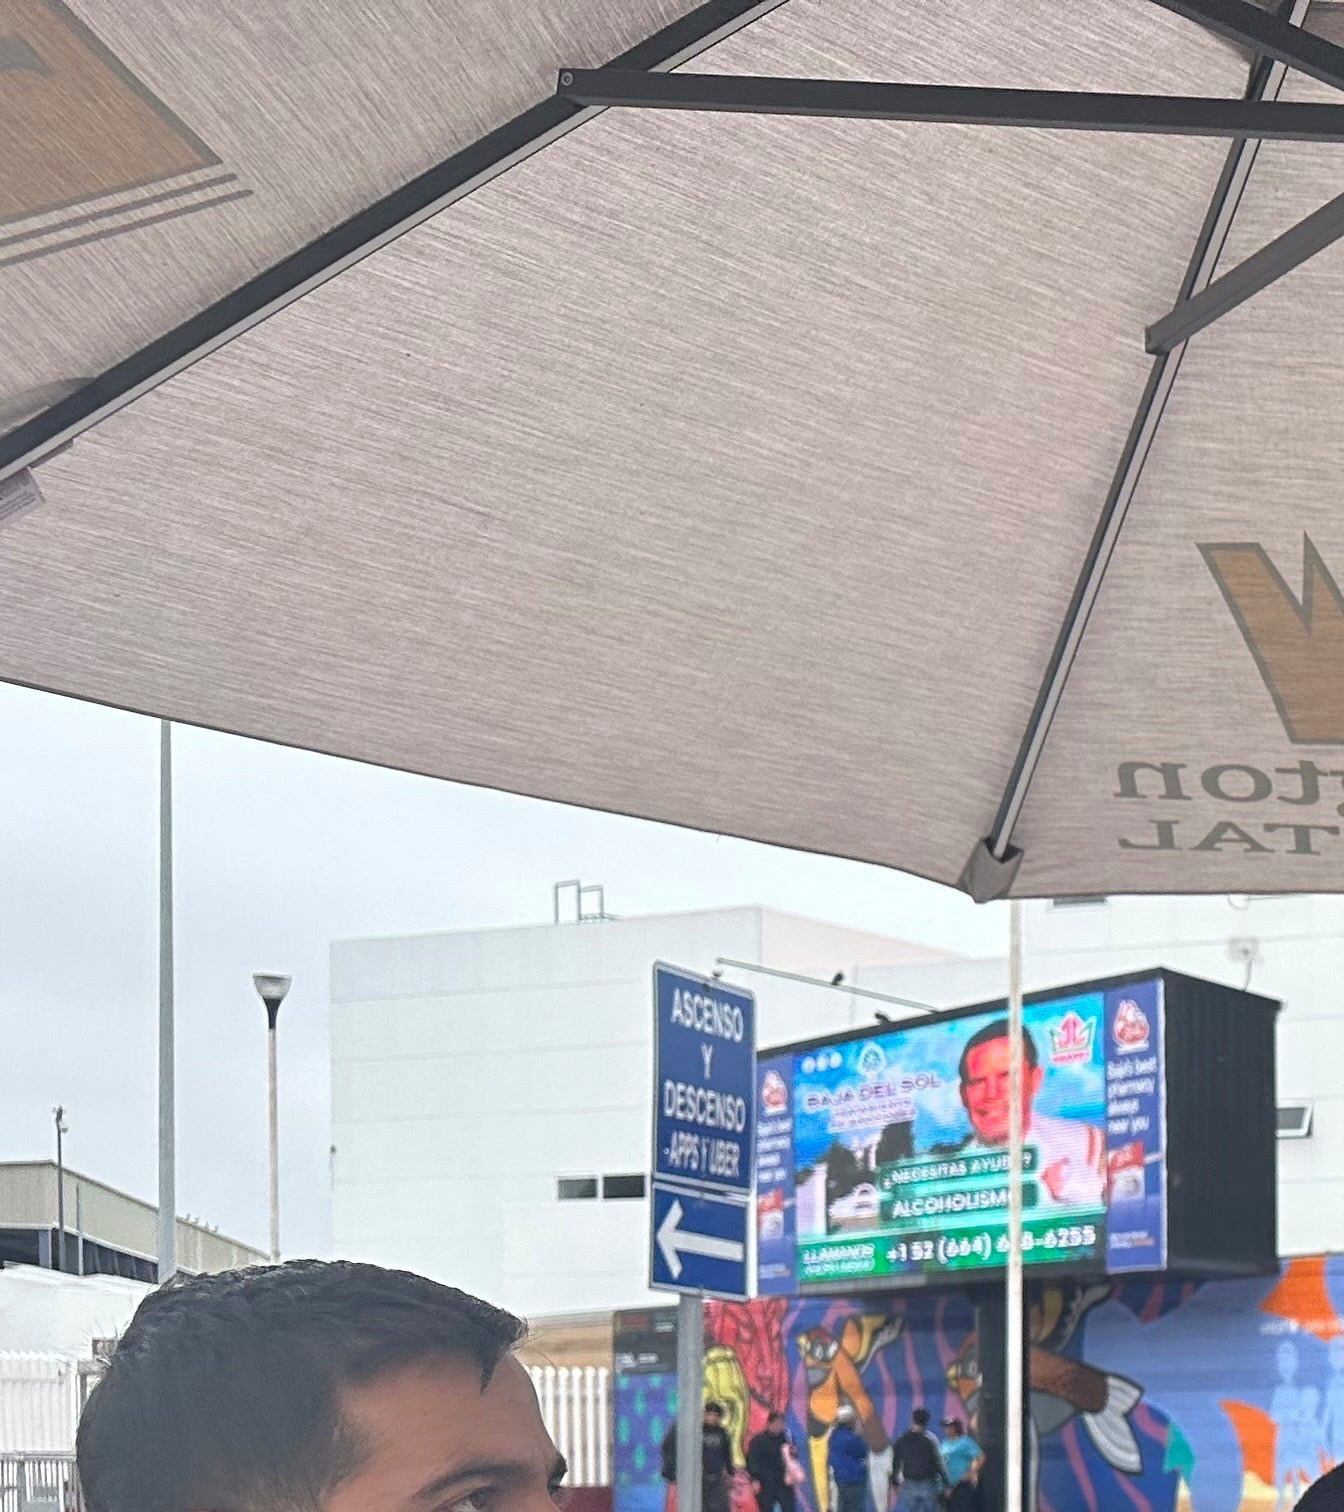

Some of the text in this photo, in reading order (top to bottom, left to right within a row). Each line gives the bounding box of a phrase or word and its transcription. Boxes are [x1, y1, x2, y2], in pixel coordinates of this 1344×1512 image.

[671, 987, 743, 1042] ASCENSO
[701, 1043, 713, 1079] Y
[860, 1083, 897, 1099] DEL
[902, 1073, 941, 1092] SOL
[663, 1078, 746, 1133] DESCENSO
[709, 1139, 740, 1178] UBER
[970, 1153, 1031, 1176] AYUD?
[892, 1190, 1014, 1219] ALCOHOLISM
